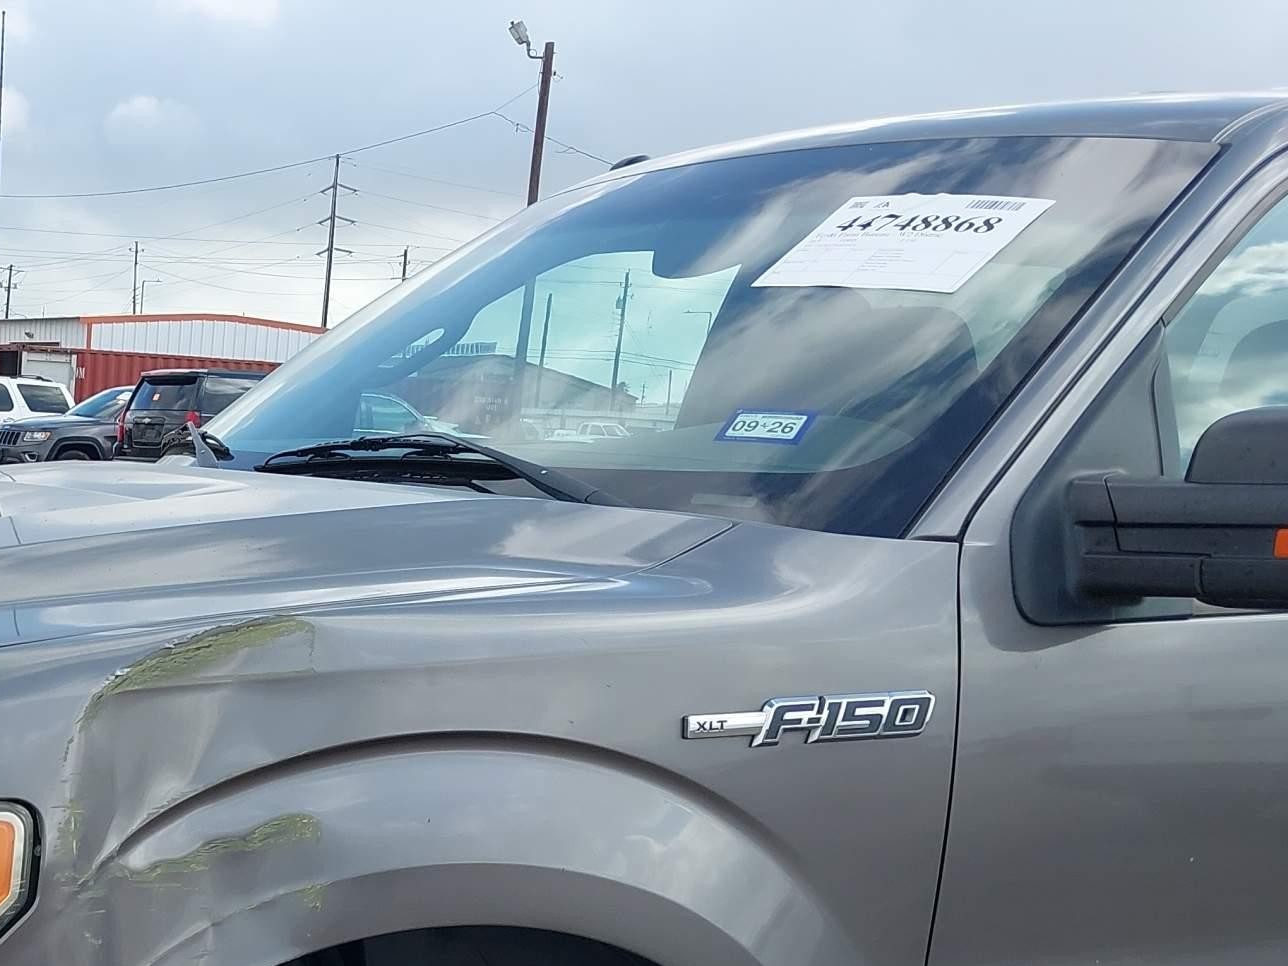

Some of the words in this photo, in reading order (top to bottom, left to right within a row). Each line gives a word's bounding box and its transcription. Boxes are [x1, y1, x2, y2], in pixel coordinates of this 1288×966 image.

[836, 213, 1003, 233] 44748868
[732, 420, 759, 432] 09
[766, 421, 796, 434] 26
[695, 720, 727, 732] XLT
[752, 690, 935, 747] F-150
